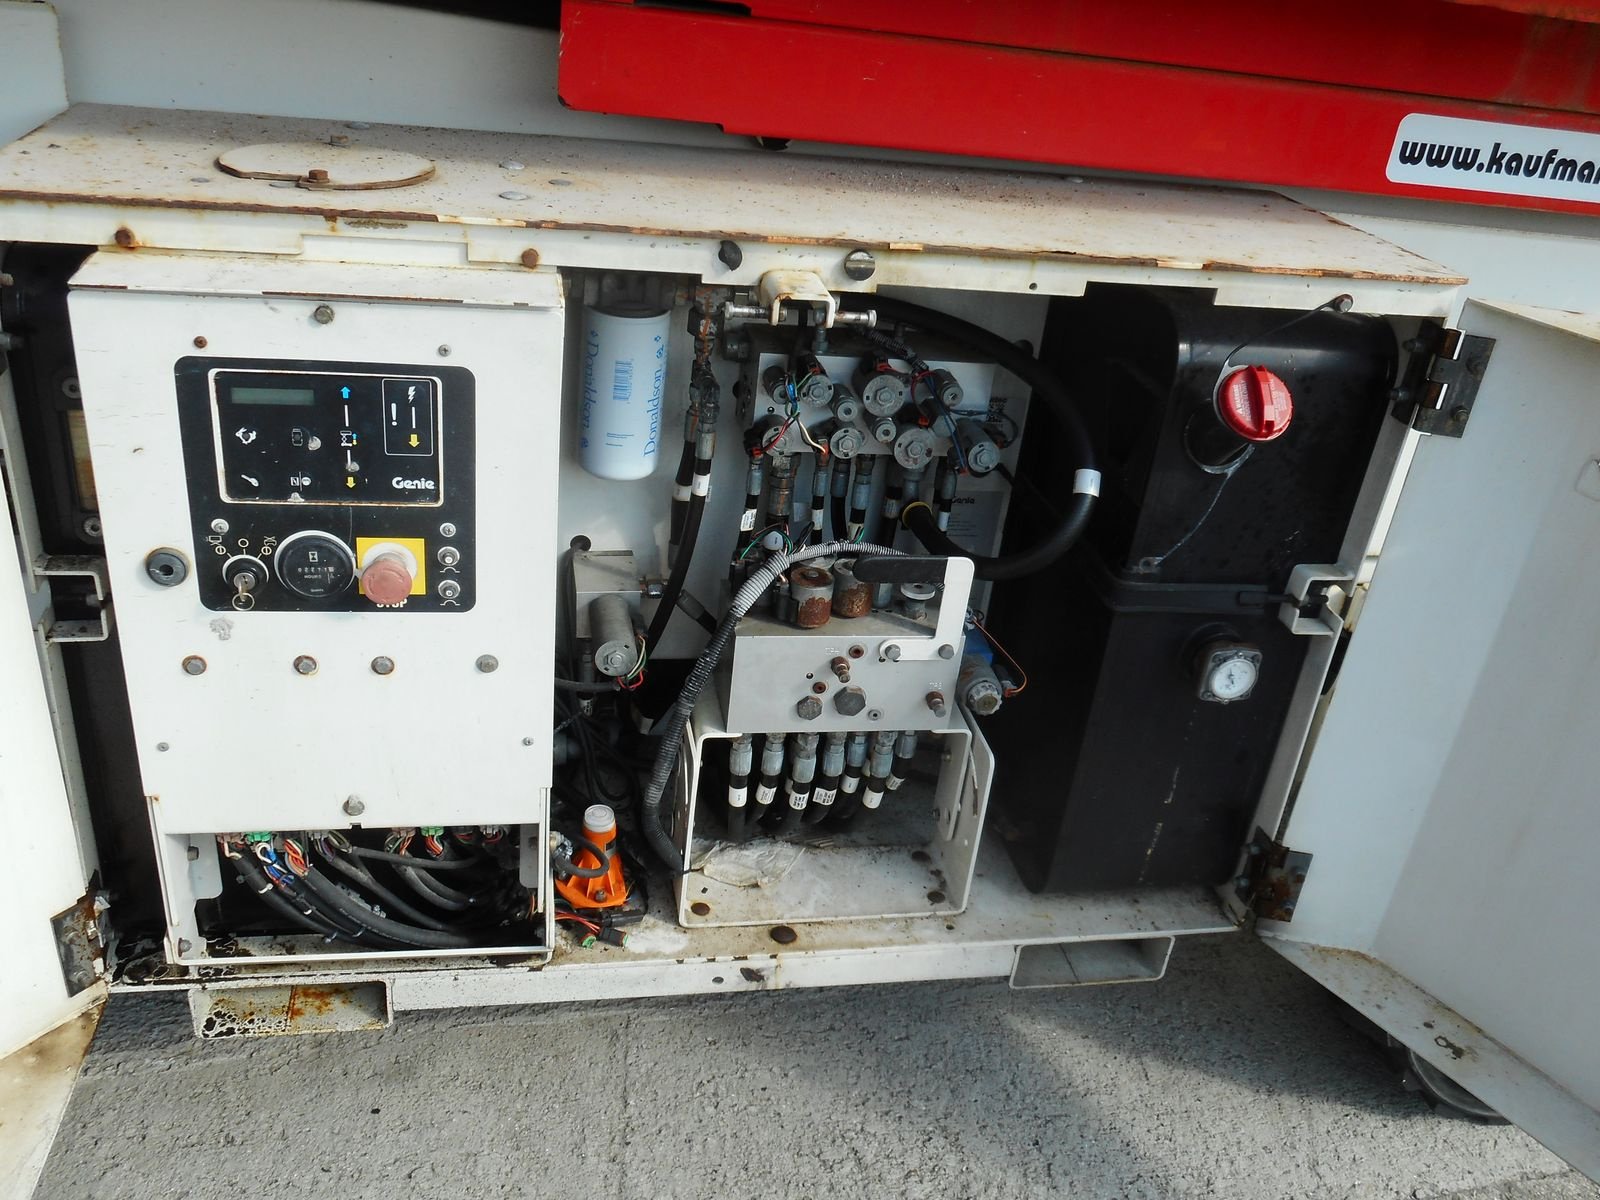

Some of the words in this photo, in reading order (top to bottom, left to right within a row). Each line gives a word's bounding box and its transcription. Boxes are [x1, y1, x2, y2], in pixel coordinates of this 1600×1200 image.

[582, 340, 599, 429] Donaldson
[643, 368, 662, 456] Donaldson
[392, 476, 435, 489] Genie
